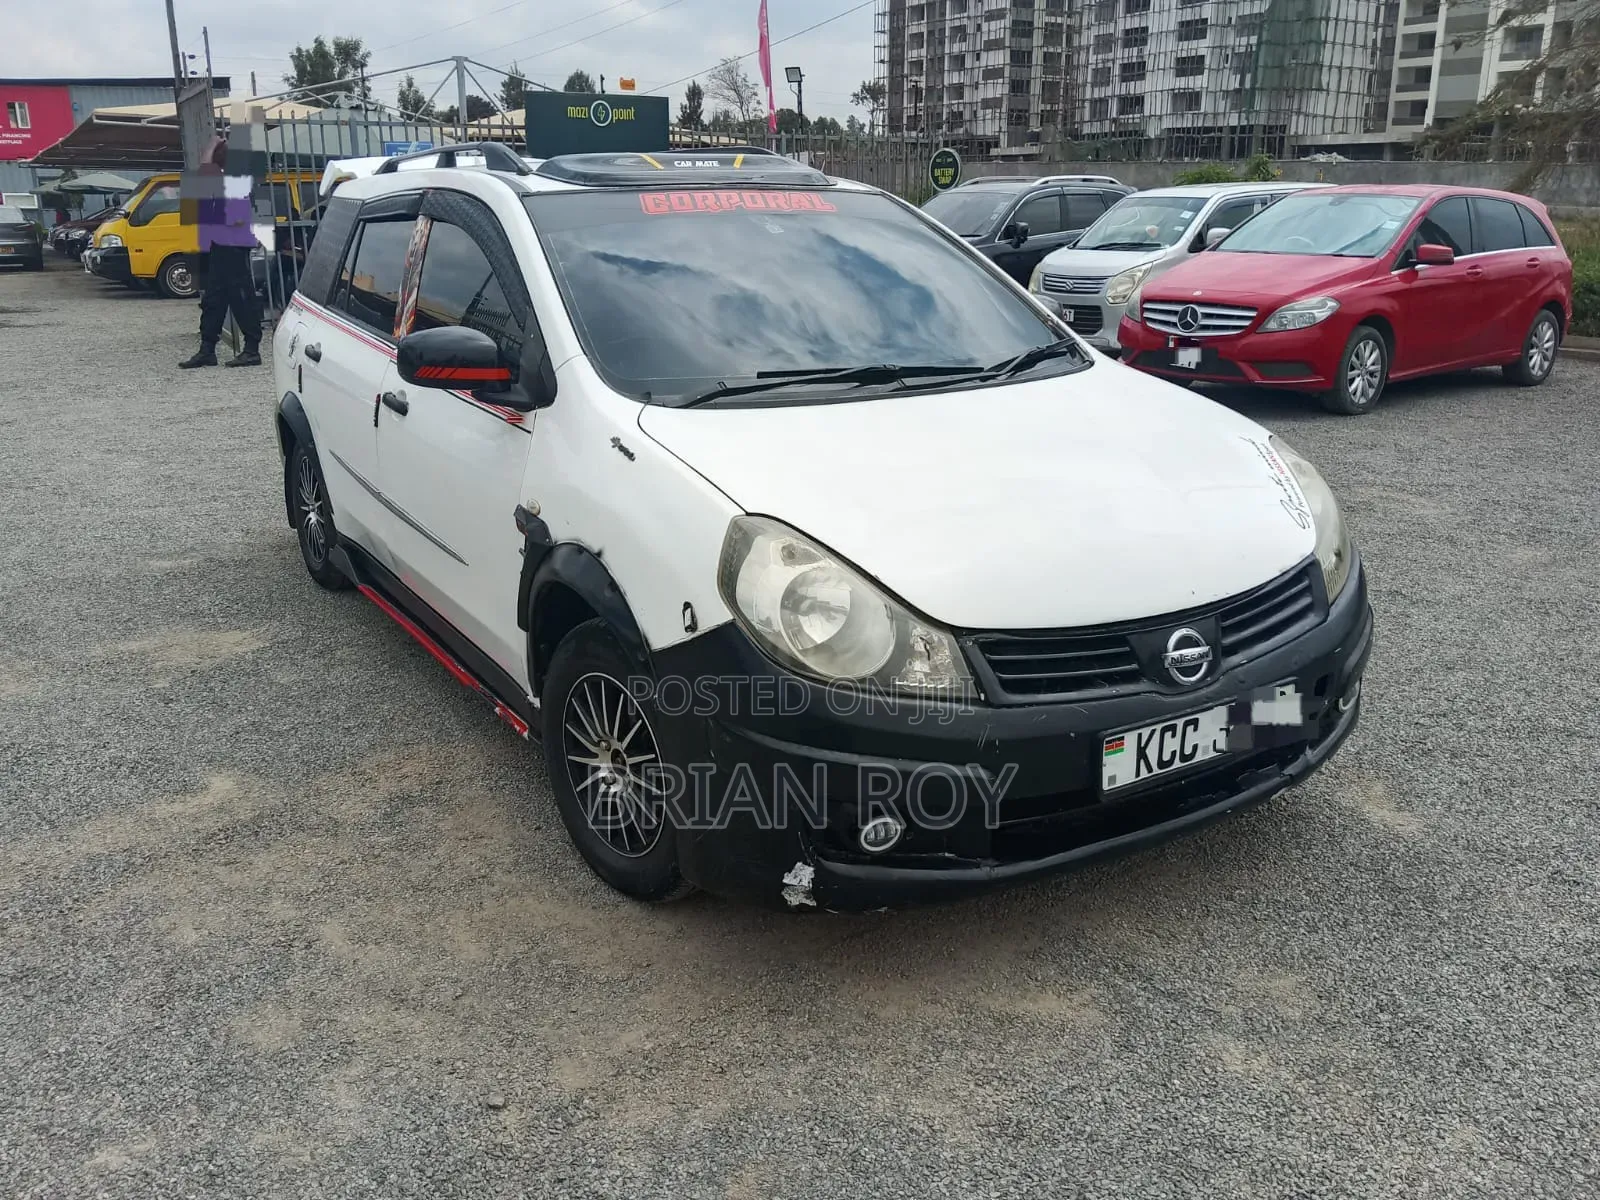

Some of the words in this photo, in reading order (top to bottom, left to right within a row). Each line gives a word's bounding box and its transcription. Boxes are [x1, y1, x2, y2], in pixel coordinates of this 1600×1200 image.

[613, 107, 635, 123] point
[934, 168, 954, 176] BATTERY
[639, 191, 836, 214] CORPORAL
[1170, 651, 1209, 666] NISSAN
[1135, 717, 1199, 778] KCC
